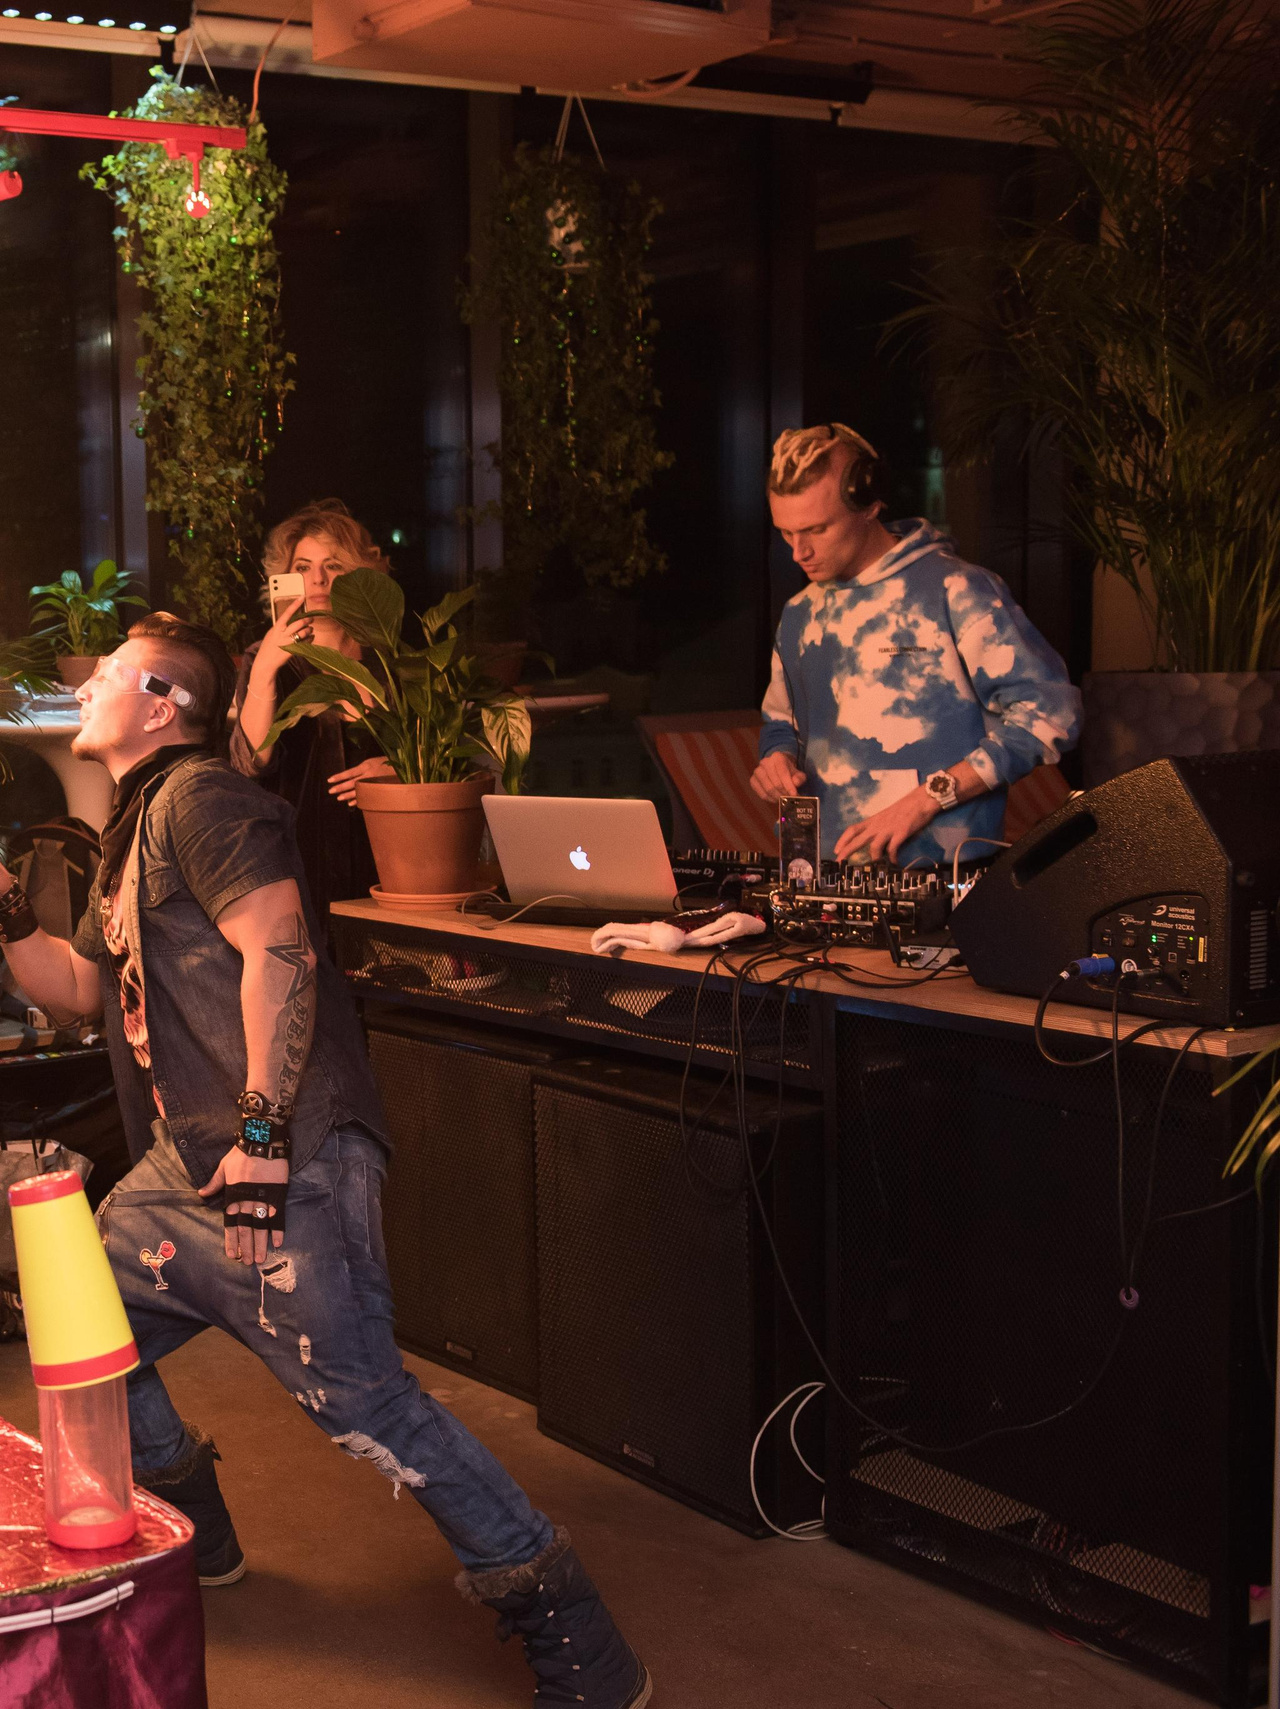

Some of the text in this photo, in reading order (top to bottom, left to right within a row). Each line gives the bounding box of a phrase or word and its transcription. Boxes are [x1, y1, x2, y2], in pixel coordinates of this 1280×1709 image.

[672, 867, 702, 875] oneer
[1168, 906, 1196, 915] universal
[1167, 912, 1196, 921] acoustics
[1150, 920, 1174, 930] Monitor
